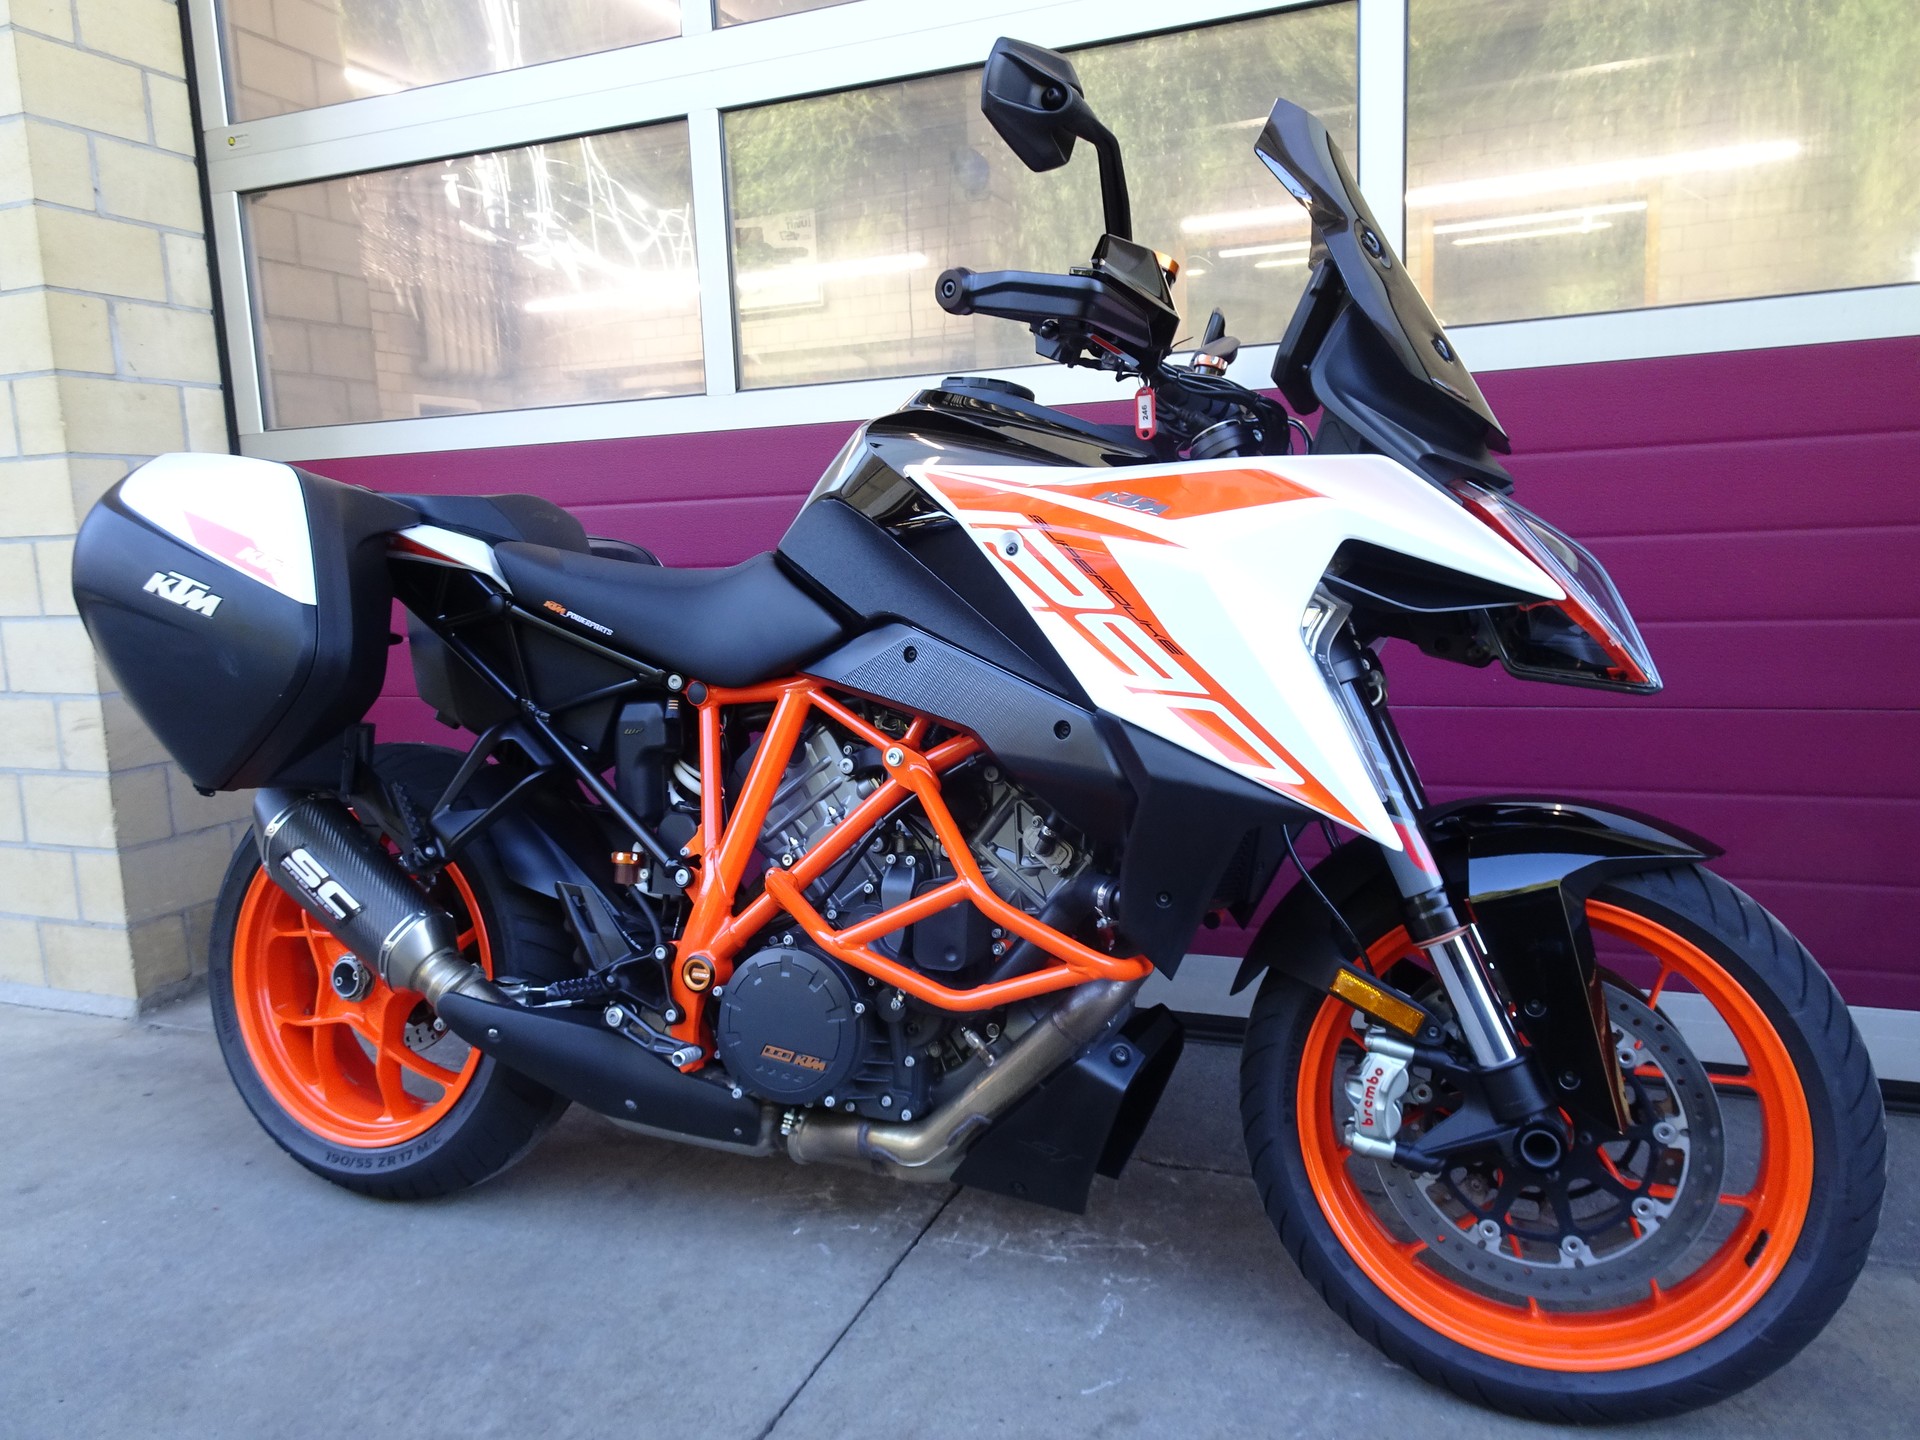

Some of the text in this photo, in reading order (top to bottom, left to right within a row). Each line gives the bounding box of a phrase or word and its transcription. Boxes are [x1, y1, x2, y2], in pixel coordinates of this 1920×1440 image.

[1141, 404, 1149, 421] 246
[1091, 490, 1171, 516] KTM
[142, 570, 224, 619] KTM
[563, 610, 614, 636] POWERPARTS
[283, 848, 361, 919] SC
[1361, 1067, 1384, 1127] brembo
[325, 1151, 373, 1169] 190/55
[376, 1156, 396, 1168] ZR
[400, 1148, 414, 1163] 17
